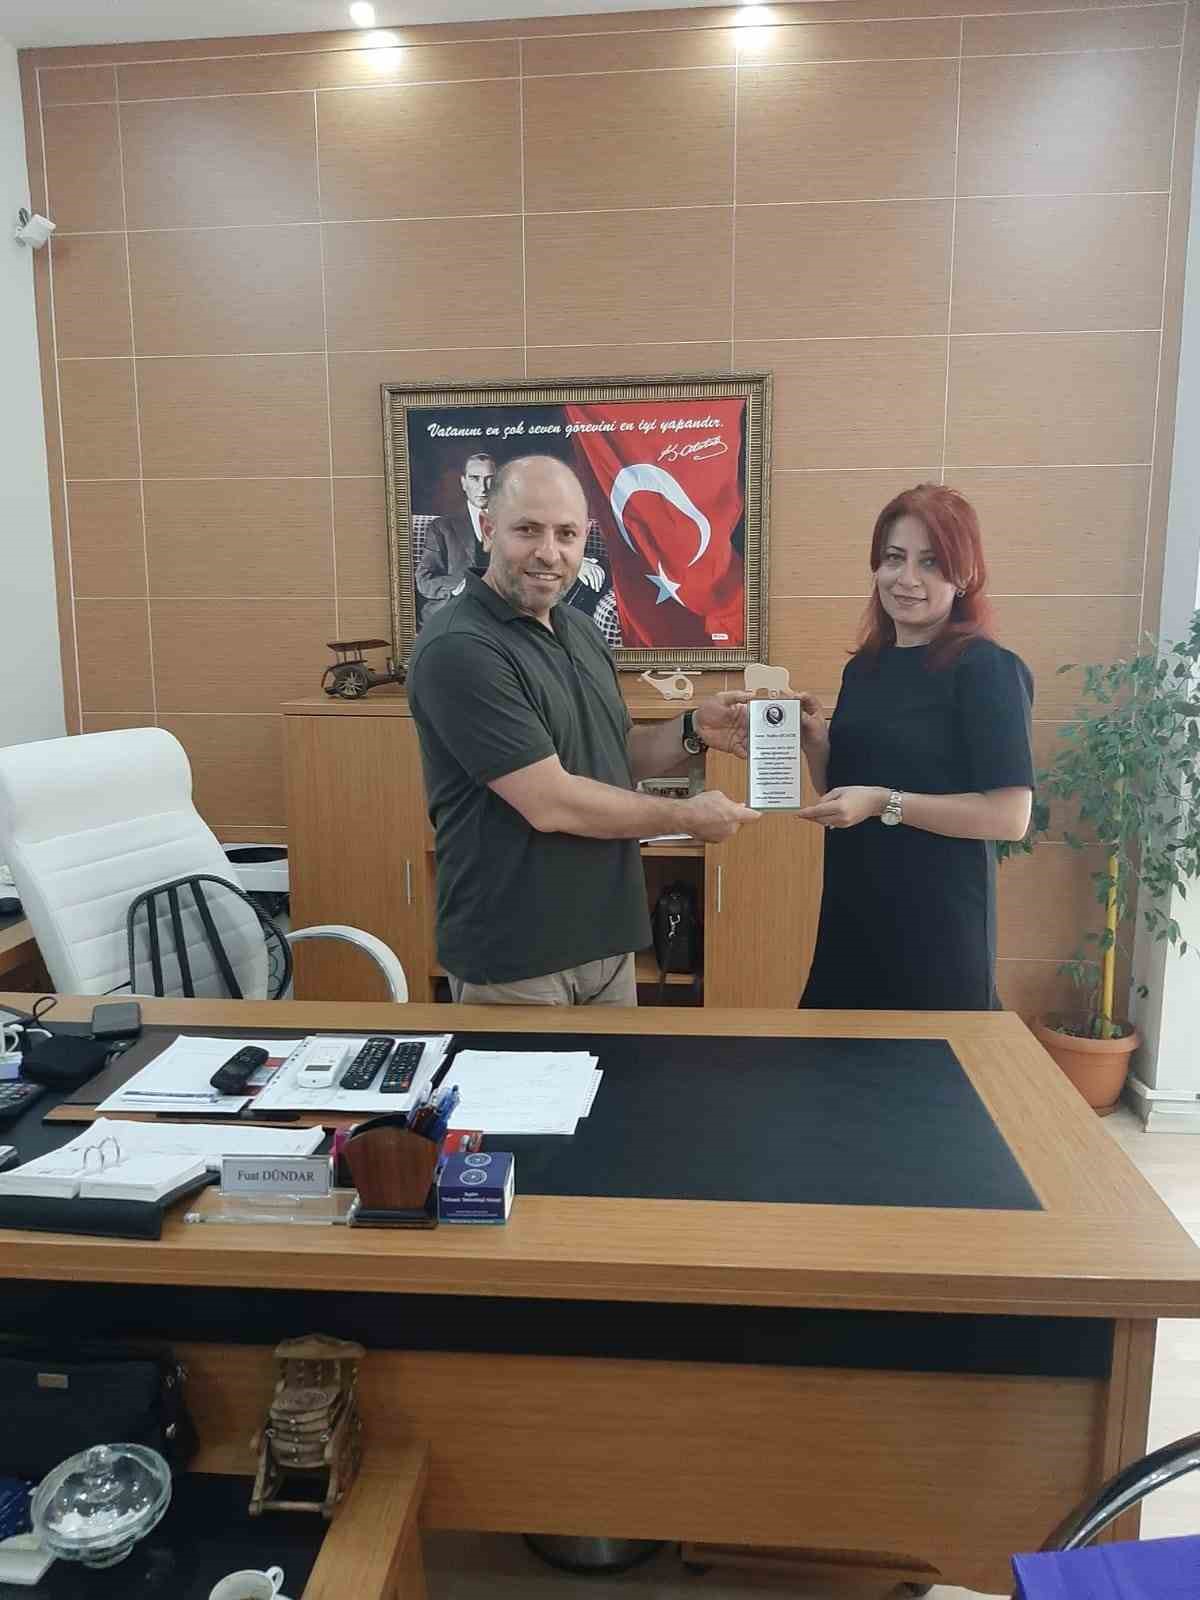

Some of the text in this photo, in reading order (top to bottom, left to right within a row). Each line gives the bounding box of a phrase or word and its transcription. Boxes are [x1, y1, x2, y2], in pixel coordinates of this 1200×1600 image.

[427, 422, 483, 438] Vatanını
[485, 427, 501, 437] en
[502, 420, 525, 440] çok
[528, 424, 562, 435] seven
[565, 420, 617, 438] görevini
[619, 423, 635, 432] en
[638, 418, 657, 435] iyi
[238, 1168, 315, 1183] Fuat DÜNDAR
